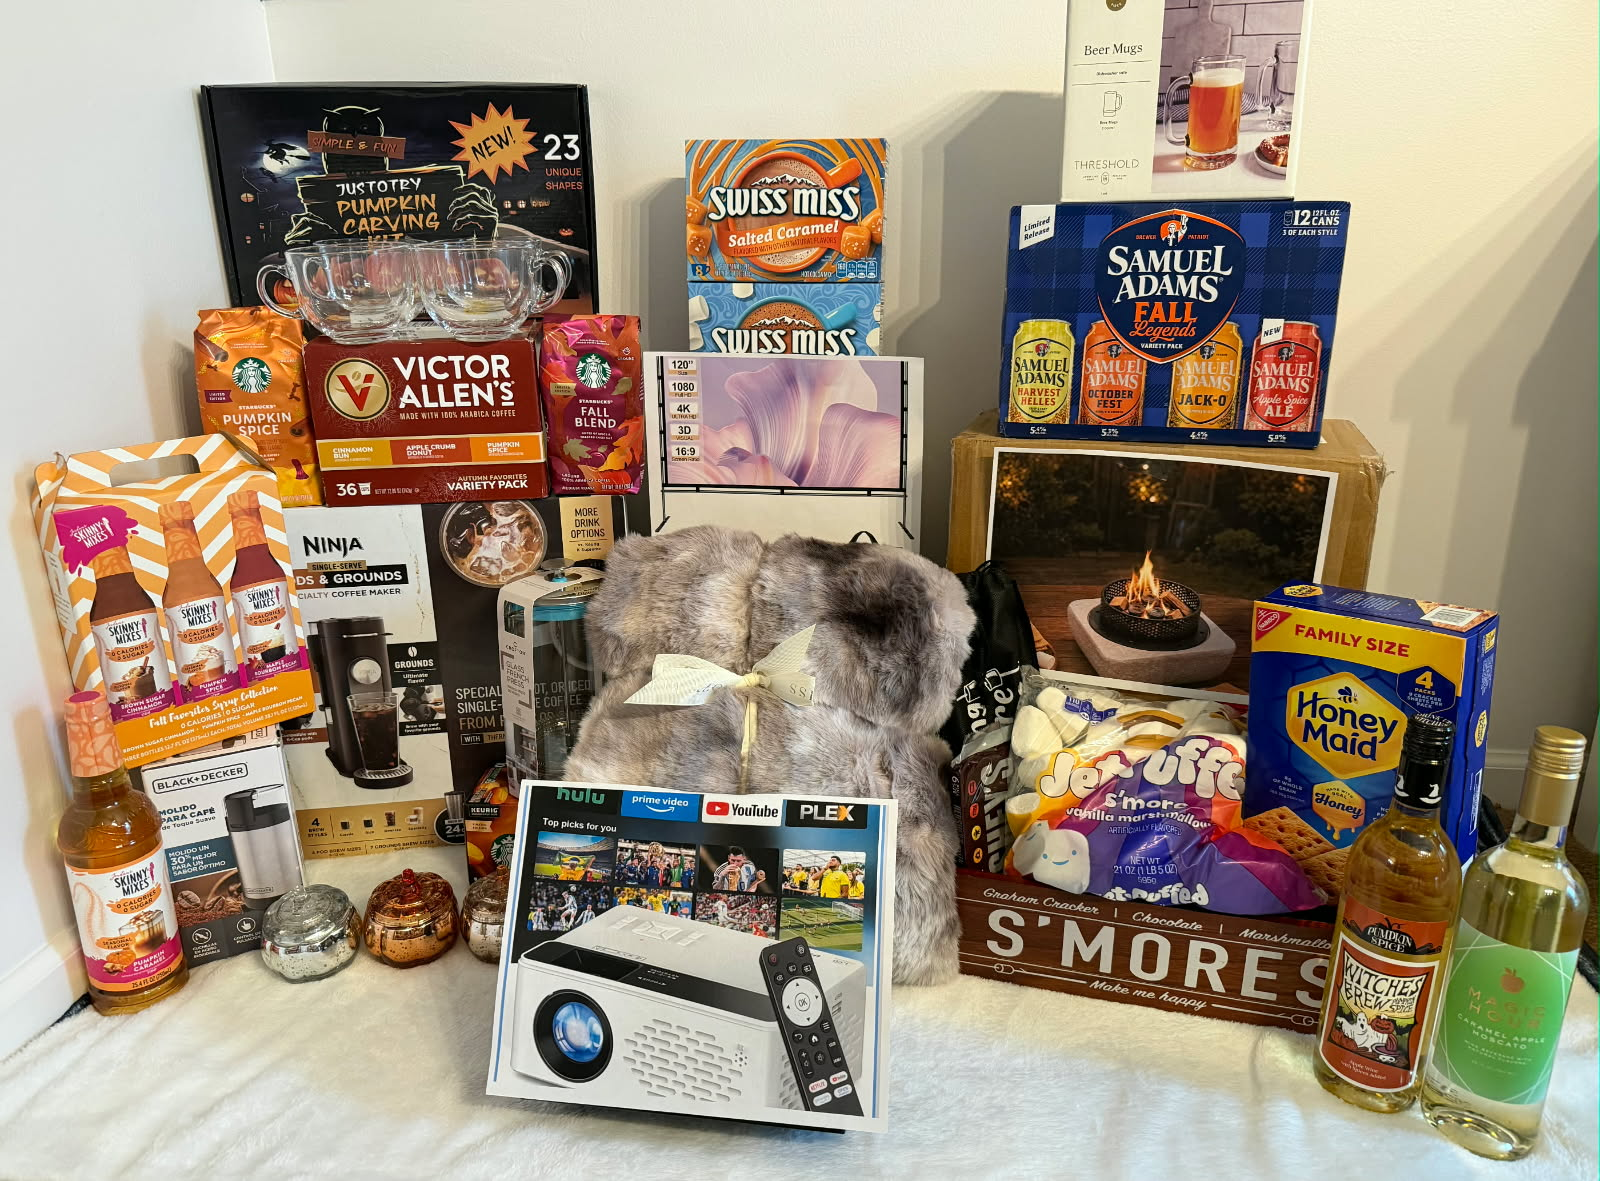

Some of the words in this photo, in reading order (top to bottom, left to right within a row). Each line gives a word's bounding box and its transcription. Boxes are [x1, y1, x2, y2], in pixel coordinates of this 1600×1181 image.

[1085, 44, 1110, 55] Beer
[1113, 43, 1142, 55] Mugs
[312, 137, 354, 150] SIMPLE
[358, 141, 368, 150] &
[372, 140, 398, 153] FUN
[472, 125, 516, 160] NEW!
[544, 134, 580, 160] 23
[1074, 159, 1139, 170] THRESHOLD
[545, 168, 582, 177] UNIQUE
[336, 178, 422, 196] JUSTOTRY
[545, 181, 583, 190] SHAPES
[336, 194, 436, 217] PUMPKIN
[708, 187, 788, 220] SWISS
[343, 212, 440, 235] CARVING
[1024, 217, 1050, 232] Limited
[1312, 217, 1340, 226] CANS
[728, 231, 774, 248] Salted
[777, 220, 839, 240] Caramel
[1024, 226, 1050, 241] Release
[1107, 245, 1233, 276] SAMUEL
[1114, 276, 1220, 303] ADAMS
[1134, 301, 1198, 323] FALL
[1129, 320, 1197, 342] Legends
[1263, 326, 1282, 337] NEW
[393, 354, 510, 380] VICTOR
[1014, 357, 1069, 372] SAMUEL
[1085, 358, 1143, 374] SAMUEL
[1176, 360, 1236, 376] SAMUEL
[1253, 361, 1314, 378] SAMUEL
[672, 383, 694, 392] 1080
[1016, 373, 1064, 387] ADAMS
[1087, 375, 1138, 389] ADAMS
[1177, 374, 1232, 391] ADAMS
[1255, 377, 1310, 393] ADAMS
[400, 380, 515, 408] ALLEN'S
[1018, 388, 1061, 397] HARVEST
[1088, 390, 1133, 398] OCTOBER
[1178, 394, 1227, 406] JACK-O
[1253, 394, 1281, 406] Apple
[1284, 394, 1309, 404] Spice
[677, 404, 690, 413] 4K
[1097, 400, 1122, 408] FEST
[1264, 406, 1293, 417] ALE
[223, 412, 292, 425] PUMPKIN
[400, 412, 419, 420] MADE
[441, 411, 458, 419] 100%
[460, 410, 490, 418] ARABICA
[581, 407, 609, 417] FALL
[238, 425, 279, 437] SPICE
[575, 418, 616, 429] BLEND
[678, 426, 691, 434] 3D
[333, 446, 373, 454] CINNAMON
[676, 447, 695, 455] 16:9
[336, 483, 357, 496] 36
[447, 481, 495, 491] VARIETY
[498, 480, 528, 489] PACK
[575, 508, 598, 516] MORE
[575, 518, 600, 527] DRINK
[74, 521, 102, 542] SKINNY
[571, 529, 605, 538] OPTIONS
[83, 531, 108, 548] MIXES
[302, 535, 364, 557] NINJA
[312, 562, 362, 570] SINGLE-SERVE
[248, 588, 274, 602] SKINNY
[181, 603, 210, 618] SKINNY
[253, 598, 275, 610] MIXES
[188, 614, 212, 627] MIXES
[109, 621, 140, 636] SKINNY
[116, 631, 141, 645] MIXES
[1295, 624, 1363, 648] FAMILY
[1366, 637, 1410, 658] SIZE
[395, 659, 434, 669] GROUNDS
[506, 661, 524, 673] GLASS
[507, 669, 529, 683] FRENCH
[507, 676, 525, 688] PRESS
[1416, 671, 1433, 689] 4
[149, 716, 168, 728] Fall
[169, 705, 210, 722] Favorites
[212, 698, 238, 710] Syrup
[240, 685, 278, 701] Collection
[460, 716, 495, 730] FROM
[1296, 691, 1398, 744] Honey
[1302, 719, 1378, 762] Maid
[157, 767, 244, 790] BLACK+DECKER
[556, 787, 605, 805] hulu
[632, 797, 659, 806] prime
[661, 797, 689, 807] video
[732, 804, 779, 818] YouTube
[1315, 792, 1363, 819] Honey
[800, 805, 854, 822] PLEX
[1066, 808, 1114, 821] vanilla
[543, 818, 559, 829] Top
[561, 820, 584, 831] picks
[586, 821, 597, 830] for
[599, 826, 617, 834] you
[169, 848, 197, 857] MOLIDO
[1130, 856, 1145, 865] NET
[1147, 857, 1160, 865] WT
[115, 868, 148, 888] SKINNY
[122, 879, 150, 897] MIXES
[983, 888, 1039, 906] Graham
[1042, 898, 1099, 916] Cracker
[1132, 912, 1203, 932] Chocolate
[1239, 928, 1332, 950] Marshmallo
[1368, 926, 1412, 947] PUMPKIN
[1371, 936, 1405, 953] SPICE
[134, 950, 165, 967] PUMPKIN
[134, 956, 165, 971] CARAMEL
[986, 908, 1329, 1009] S'MORES
[1344, 954, 1426, 997] WITCHES
[1090, 980, 1130, 996] Make
[1135, 990, 1156, 999] me
[1159, 991, 1207, 1012] happy
[1345, 978, 1392, 1011] BREW
[1469, 986, 1545, 1018] MAGIC
[1469, 1001, 1540, 1029] HOUR
[1458, 1013, 1507, 1038] CARAMEL
[1473, 1030, 1527, 1050] MOSCATO
